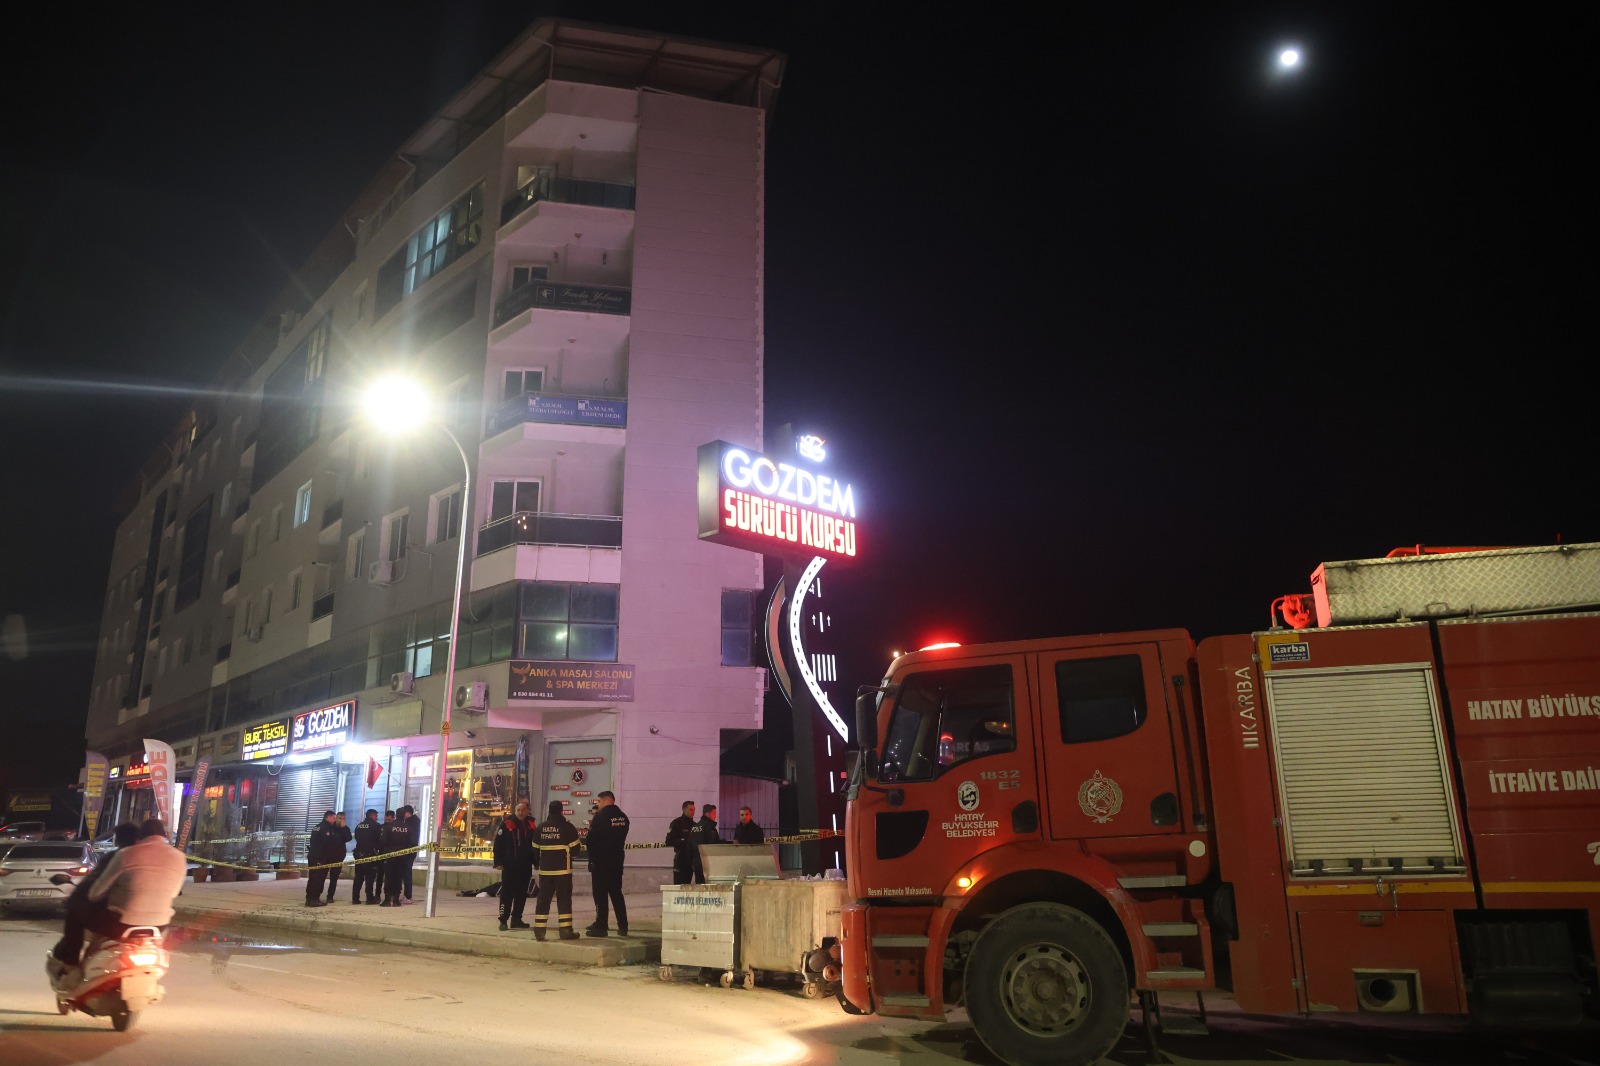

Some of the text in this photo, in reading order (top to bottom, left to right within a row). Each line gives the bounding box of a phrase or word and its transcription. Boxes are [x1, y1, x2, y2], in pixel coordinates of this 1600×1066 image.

[724, 488, 856, 557] SÜRÜCÜ KURSU
[1272, 644, 1306, 654] karba
[529, 668, 632, 679] ANKA MASAJ SALONU
[546, 680, 552, 688] &
[556, 680, 574, 689] SPA
[1468, 699, 1522, 720] HATAY
[980, 770, 1020, 780] 1832
[998, 781, 1020, 790] E5
[1489, 768, 1560, 793] İTFAİYE
[954, 812, 984, 821] HATAY
[868, 888, 882, 896] Resmi
